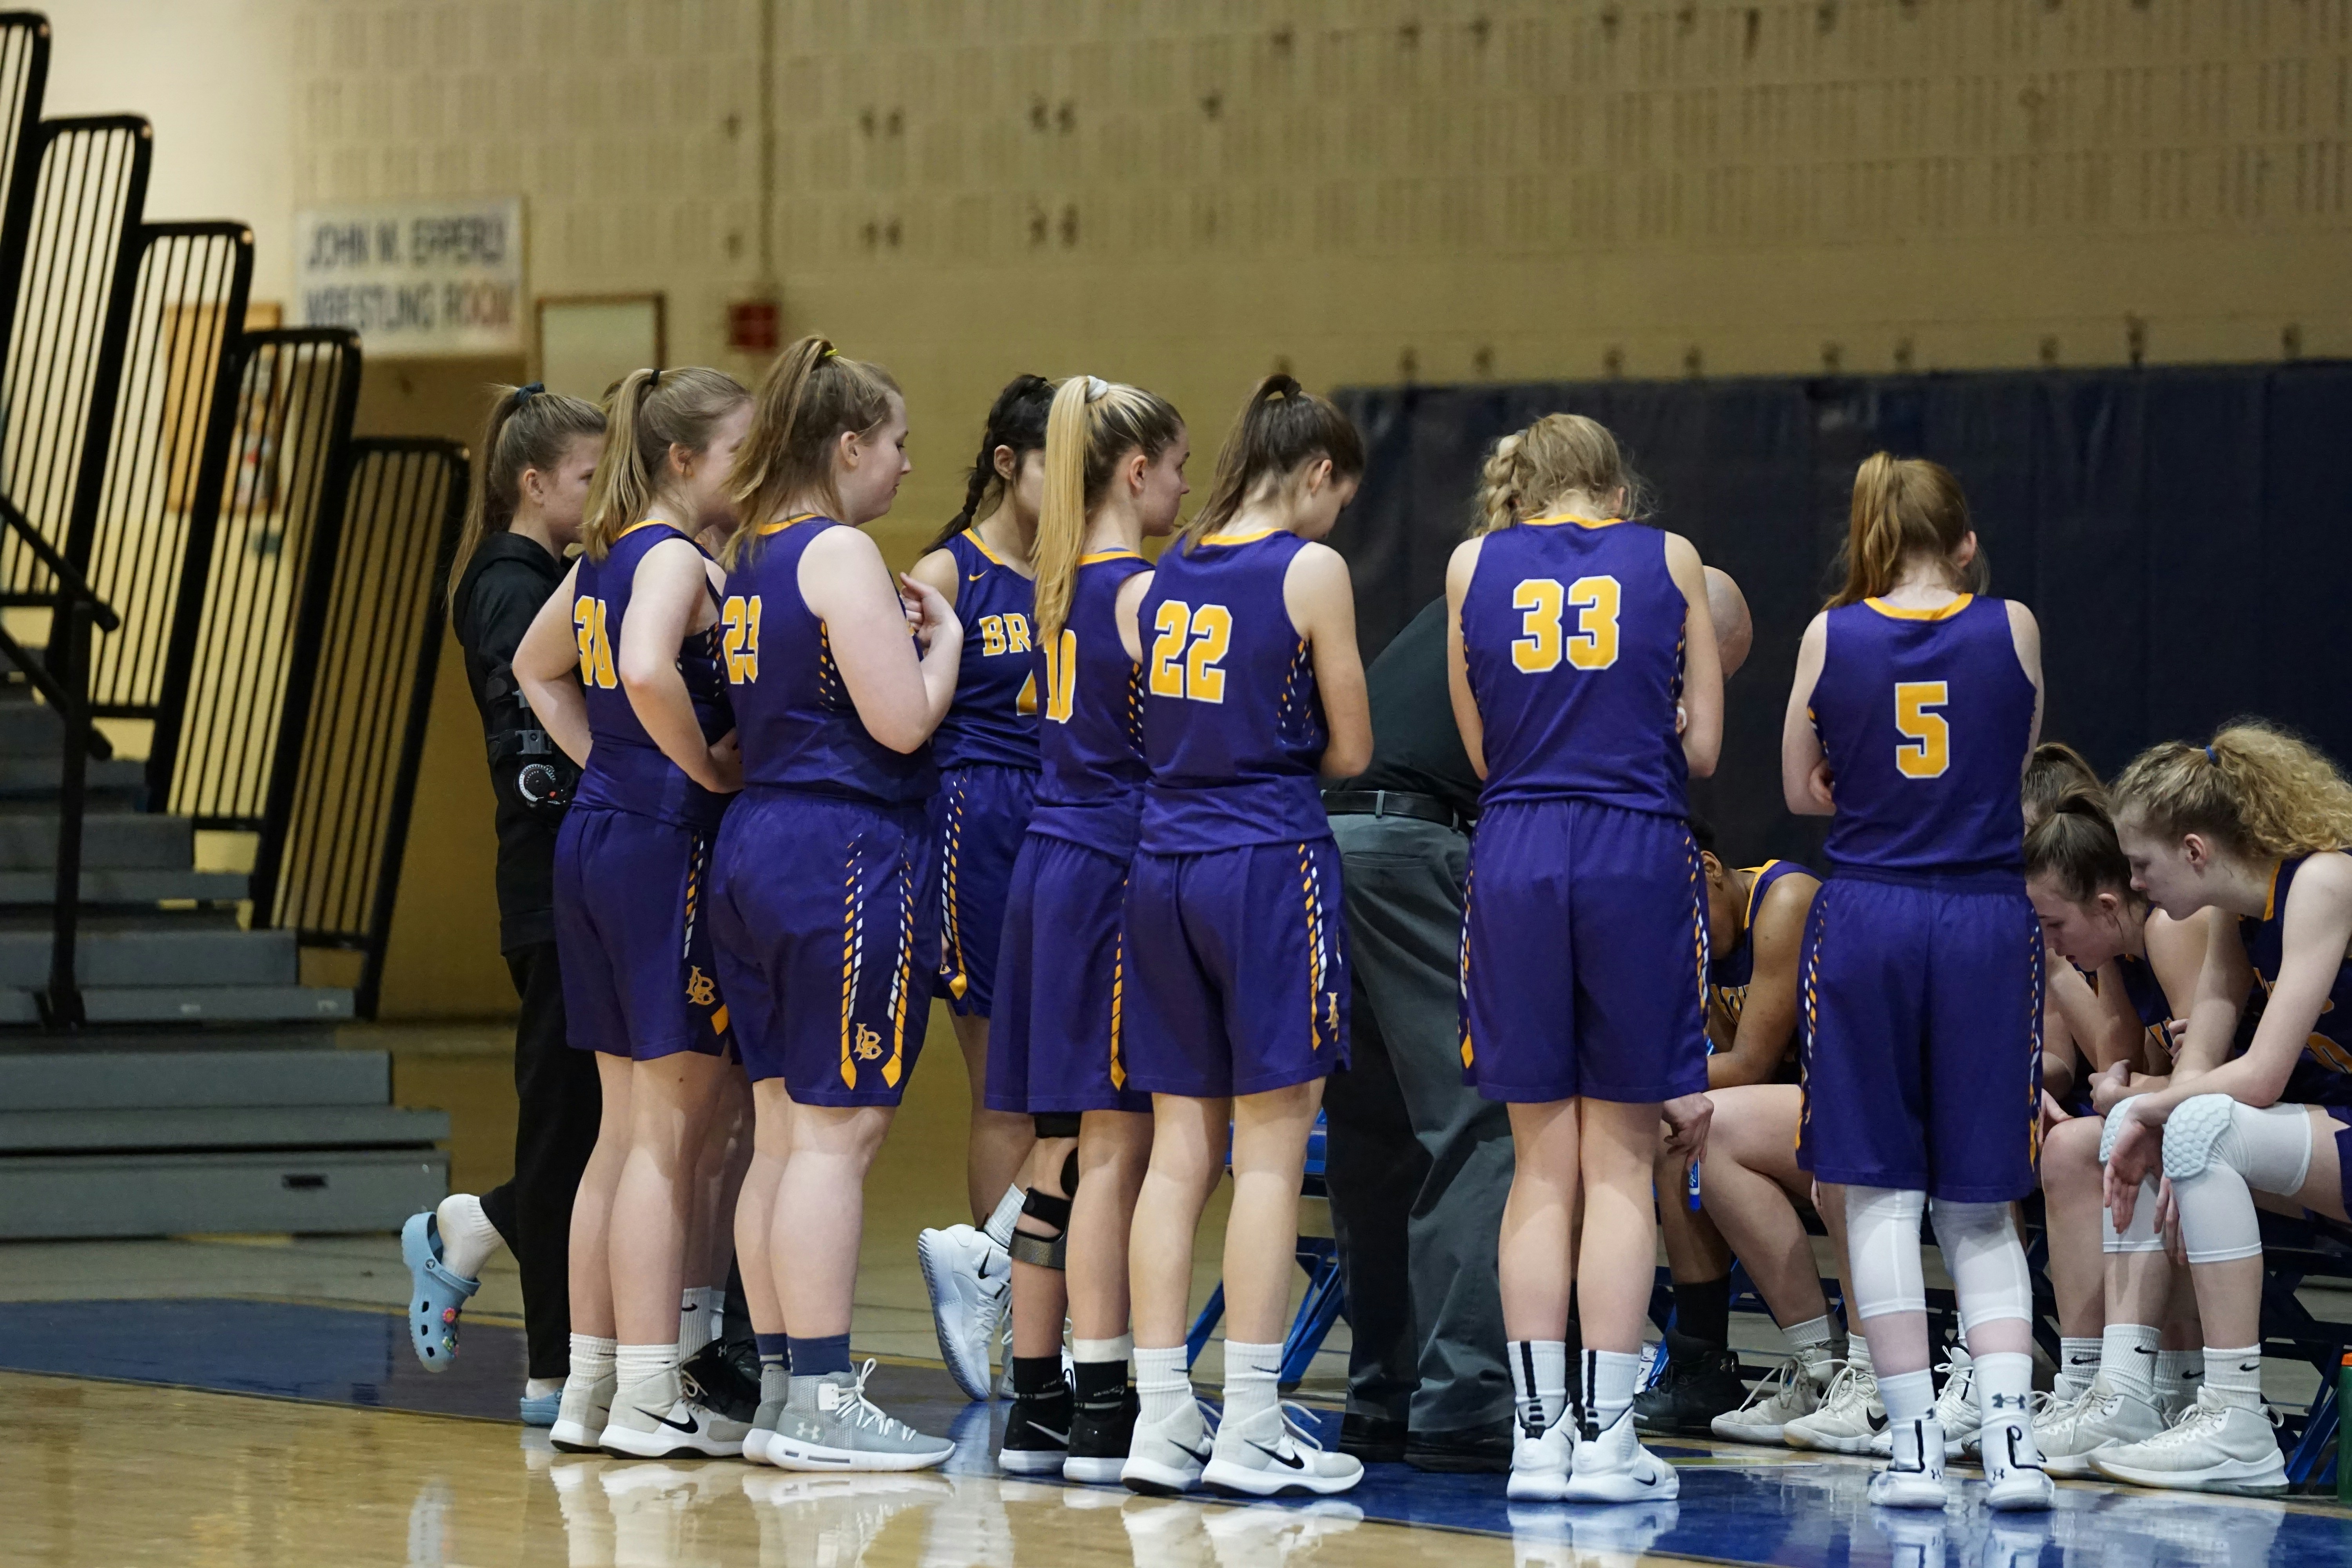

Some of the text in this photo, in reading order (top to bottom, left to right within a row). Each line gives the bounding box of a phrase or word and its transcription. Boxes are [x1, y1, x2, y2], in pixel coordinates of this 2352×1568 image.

[574, 595, 618, 689] 30
[722, 595, 762, 684] 23
[979, 613, 1031, 657] BR
[1150, 599, 1232, 704] 22
[1512, 575, 1621, 674] 33
[1895, 681, 1949, 779] 5
